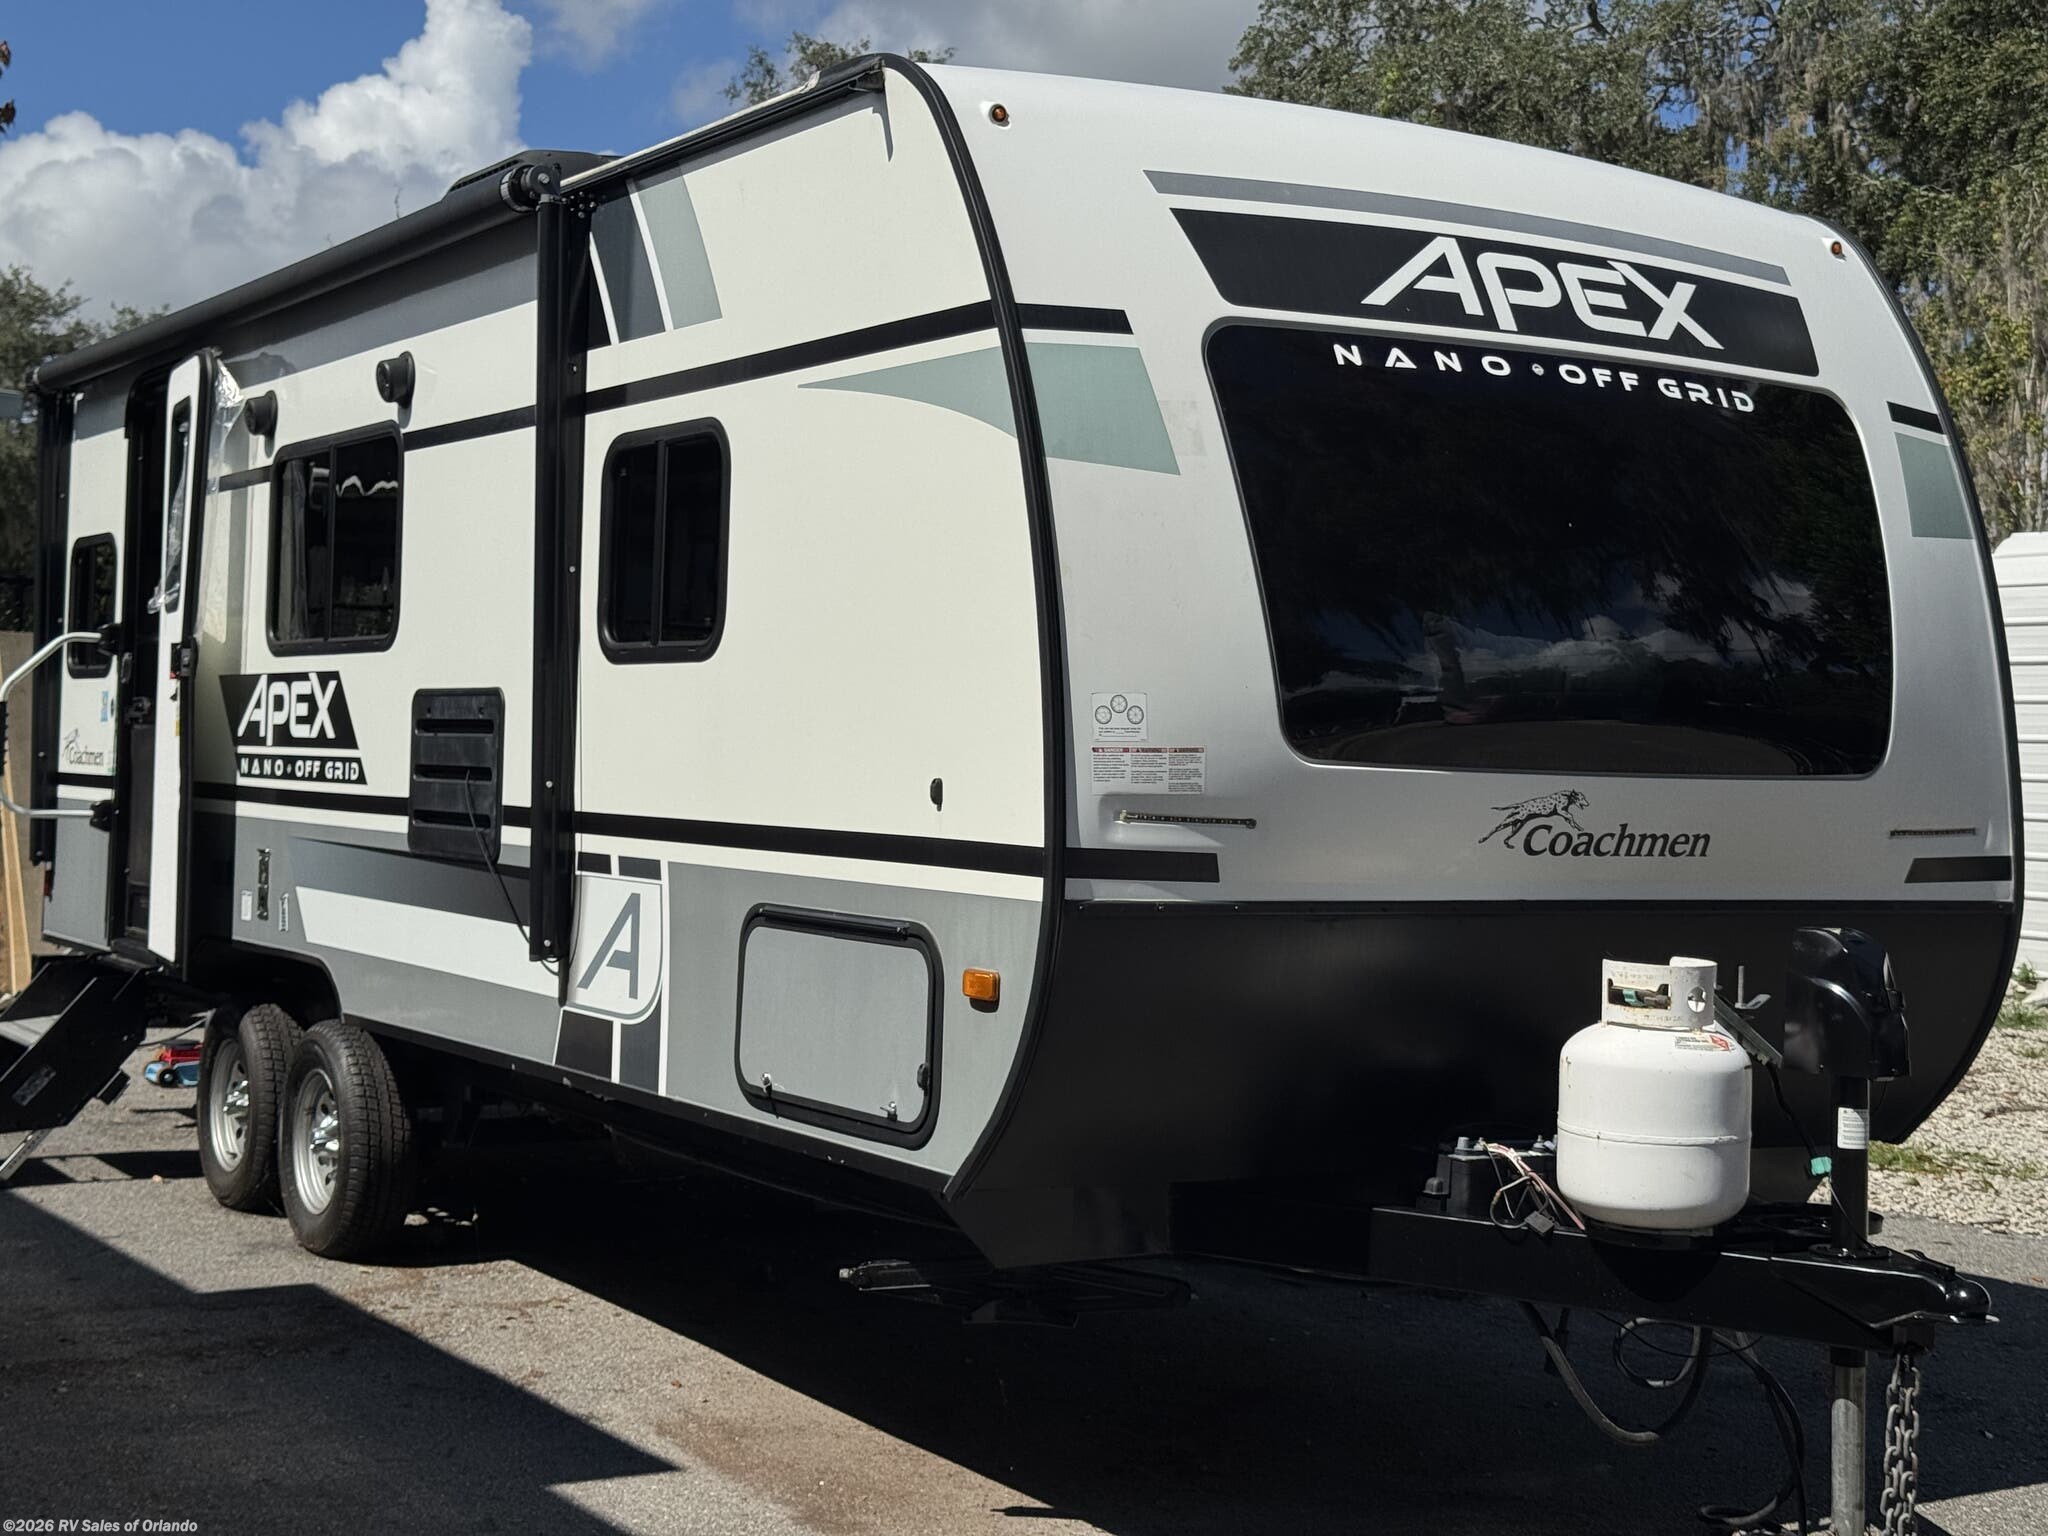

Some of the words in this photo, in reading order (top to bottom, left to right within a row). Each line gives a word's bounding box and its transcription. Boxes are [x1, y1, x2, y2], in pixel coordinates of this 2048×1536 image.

[1361, 236, 1725, 350] APEX
[1332, 343, 1512, 376] NANO
[1558, 363, 1639, 392] OFF
[1657, 377, 1755, 414] GRID
[237, 671, 338, 747] APEX
[240, 757, 285, 777] NANO
[294, 759, 321, 778] OFF
[324, 760, 360, 781] GRID
[1523, 823, 1711, 858] Coachmen
[577, 892, 641, 1000] A
